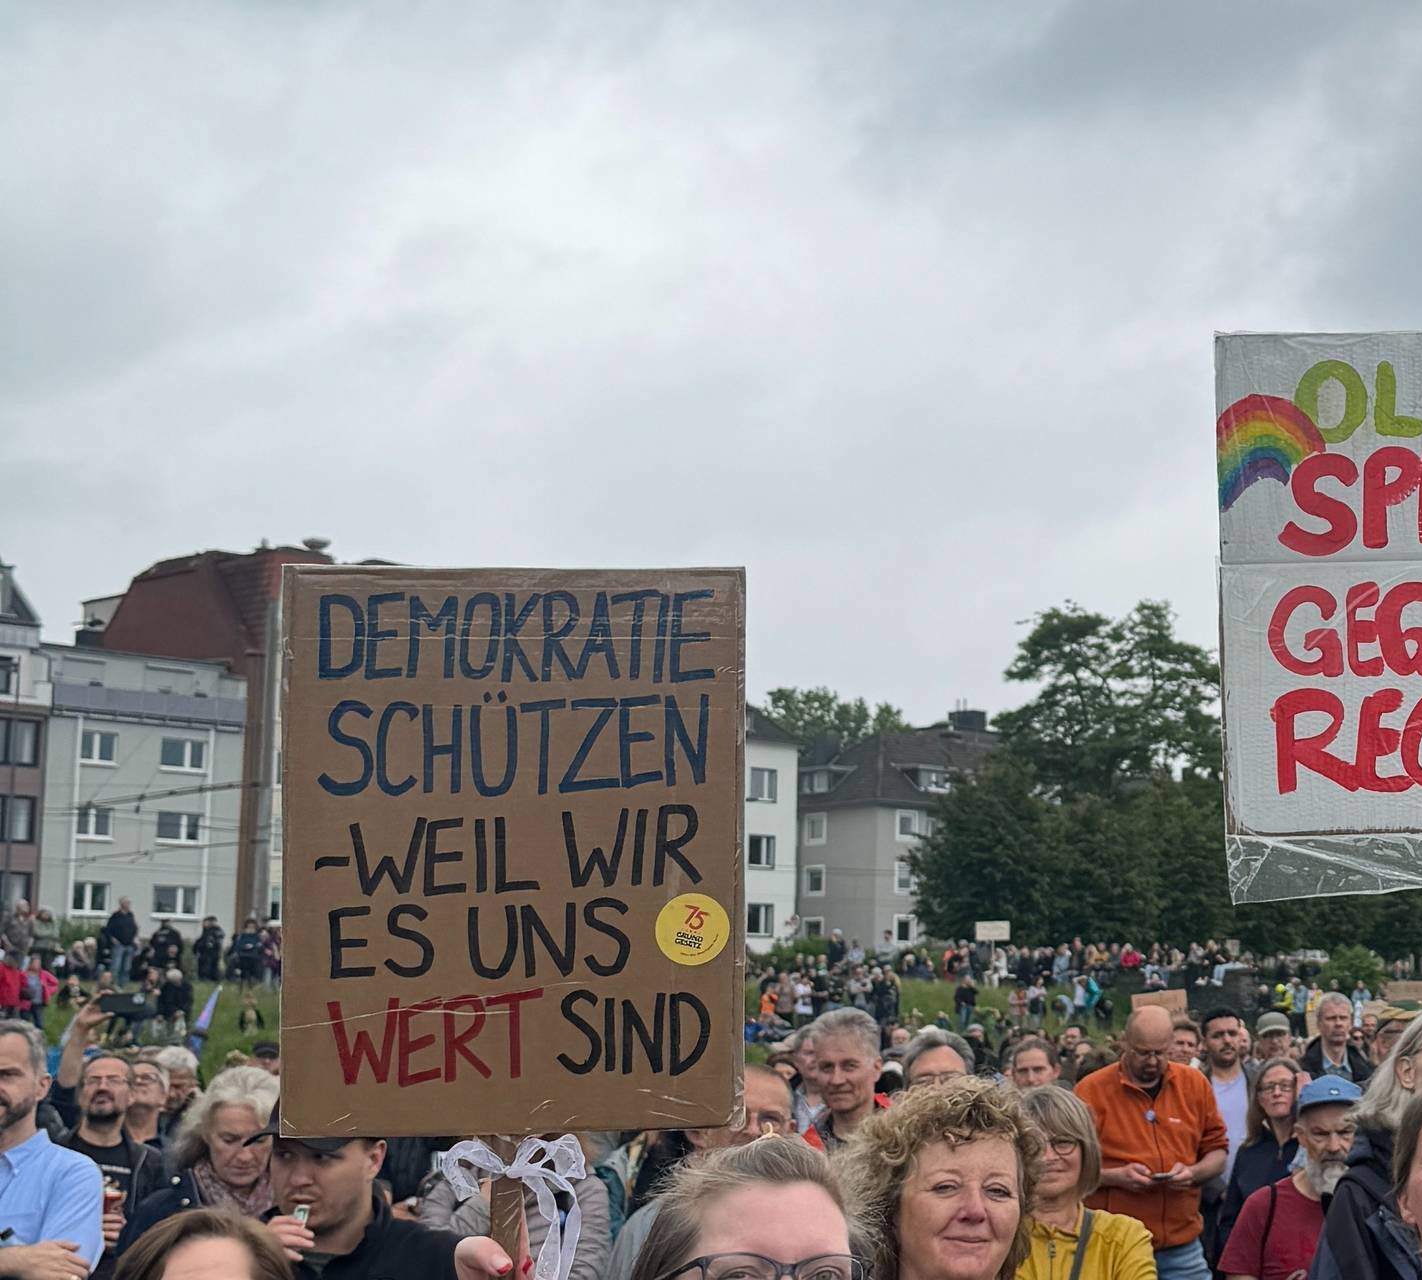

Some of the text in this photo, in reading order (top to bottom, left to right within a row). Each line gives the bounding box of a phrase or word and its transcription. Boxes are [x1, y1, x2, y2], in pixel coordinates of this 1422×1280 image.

[318, 588, 716, 683] DEMOKRATIE
[317, 691, 710, 797] SCHÜTZEN
[561, 804, 703, 888] WIR
[328, 897, 629, 979] ES UNS
[685, 904, 710, 930] 75
[326, 988, 711, 1087] WERT SIND
